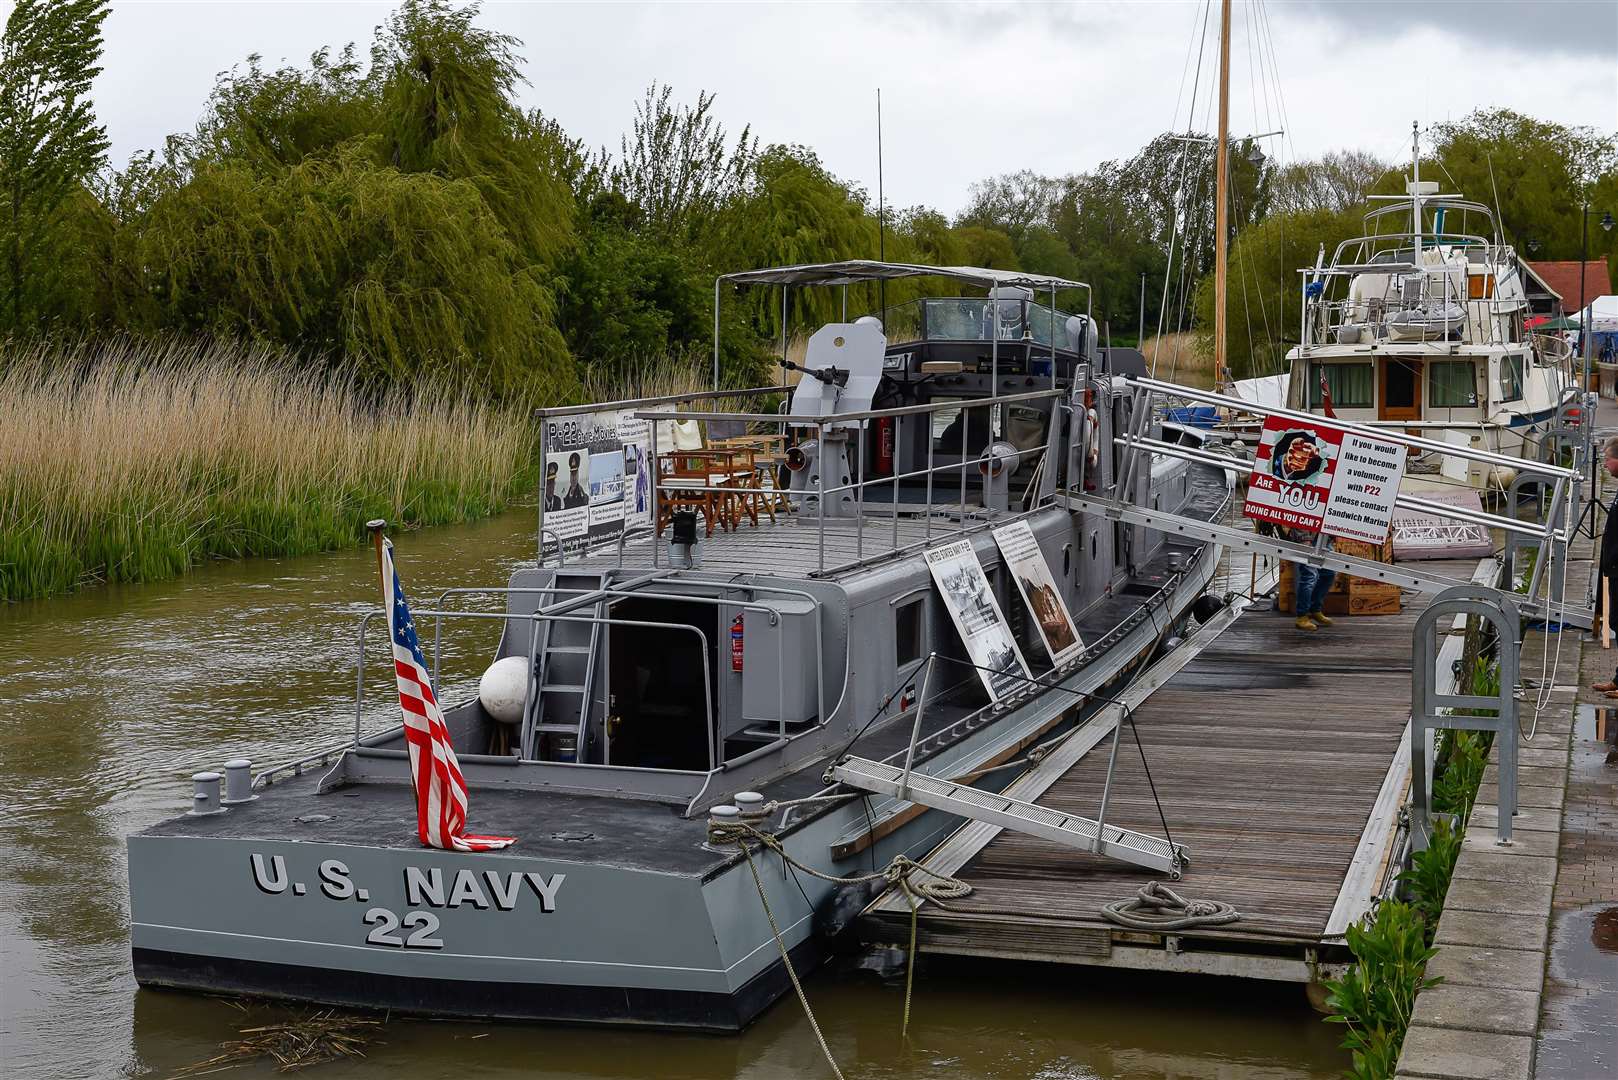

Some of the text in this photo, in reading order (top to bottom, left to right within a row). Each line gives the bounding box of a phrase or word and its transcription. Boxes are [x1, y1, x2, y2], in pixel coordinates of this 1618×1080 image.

[548, 420, 577, 446] P-22
[593, 424, 616, 442] Movies
[1352, 438, 1397, 455] If you would
[1344, 451, 1398, 470] like to become
[1353, 469, 1388, 483] volunteer
[1278, 483, 1321, 511] YOU
[1347, 482, 1382, 497] with P22
[1245, 504, 1269, 516] DOING
[1269, 510, 1282, 520] ALL
[1283, 512, 1298, 523] YOU
[1334, 495, 1388, 513] please contact
[1327, 507, 1362, 522] Sandwich
[1363, 515, 1389, 528] Marina
[1323, 523, 1385, 541] sandwichmarina.co.uk
[403, 865, 566, 912] NAVY
[362, 907, 444, 949] 22
